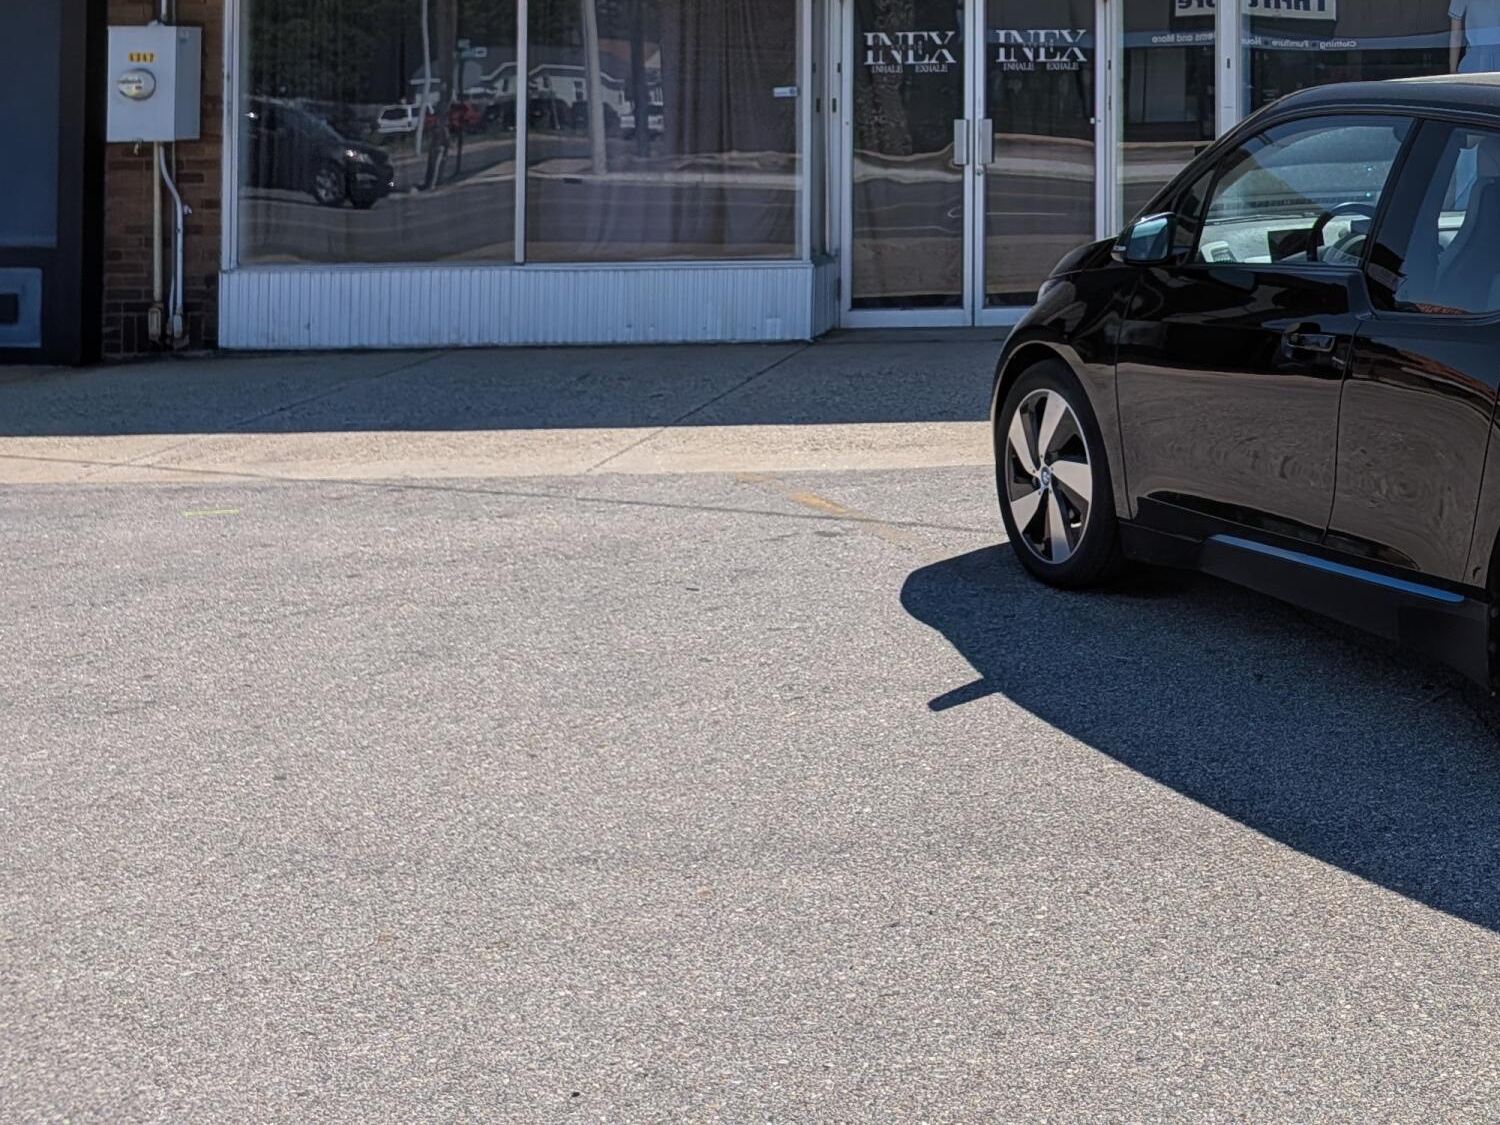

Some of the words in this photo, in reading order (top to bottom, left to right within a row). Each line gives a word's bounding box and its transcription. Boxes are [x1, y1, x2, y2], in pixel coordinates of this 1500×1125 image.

[864, 31, 957, 65] INEX
[996, 28, 1088, 62] INEX
[871, 65, 903, 74] INHALE
[915, 64, 948, 73] EXHALE
[1003, 62, 1035, 71] INHALE
[1046, 61, 1080, 70] EXHALE
